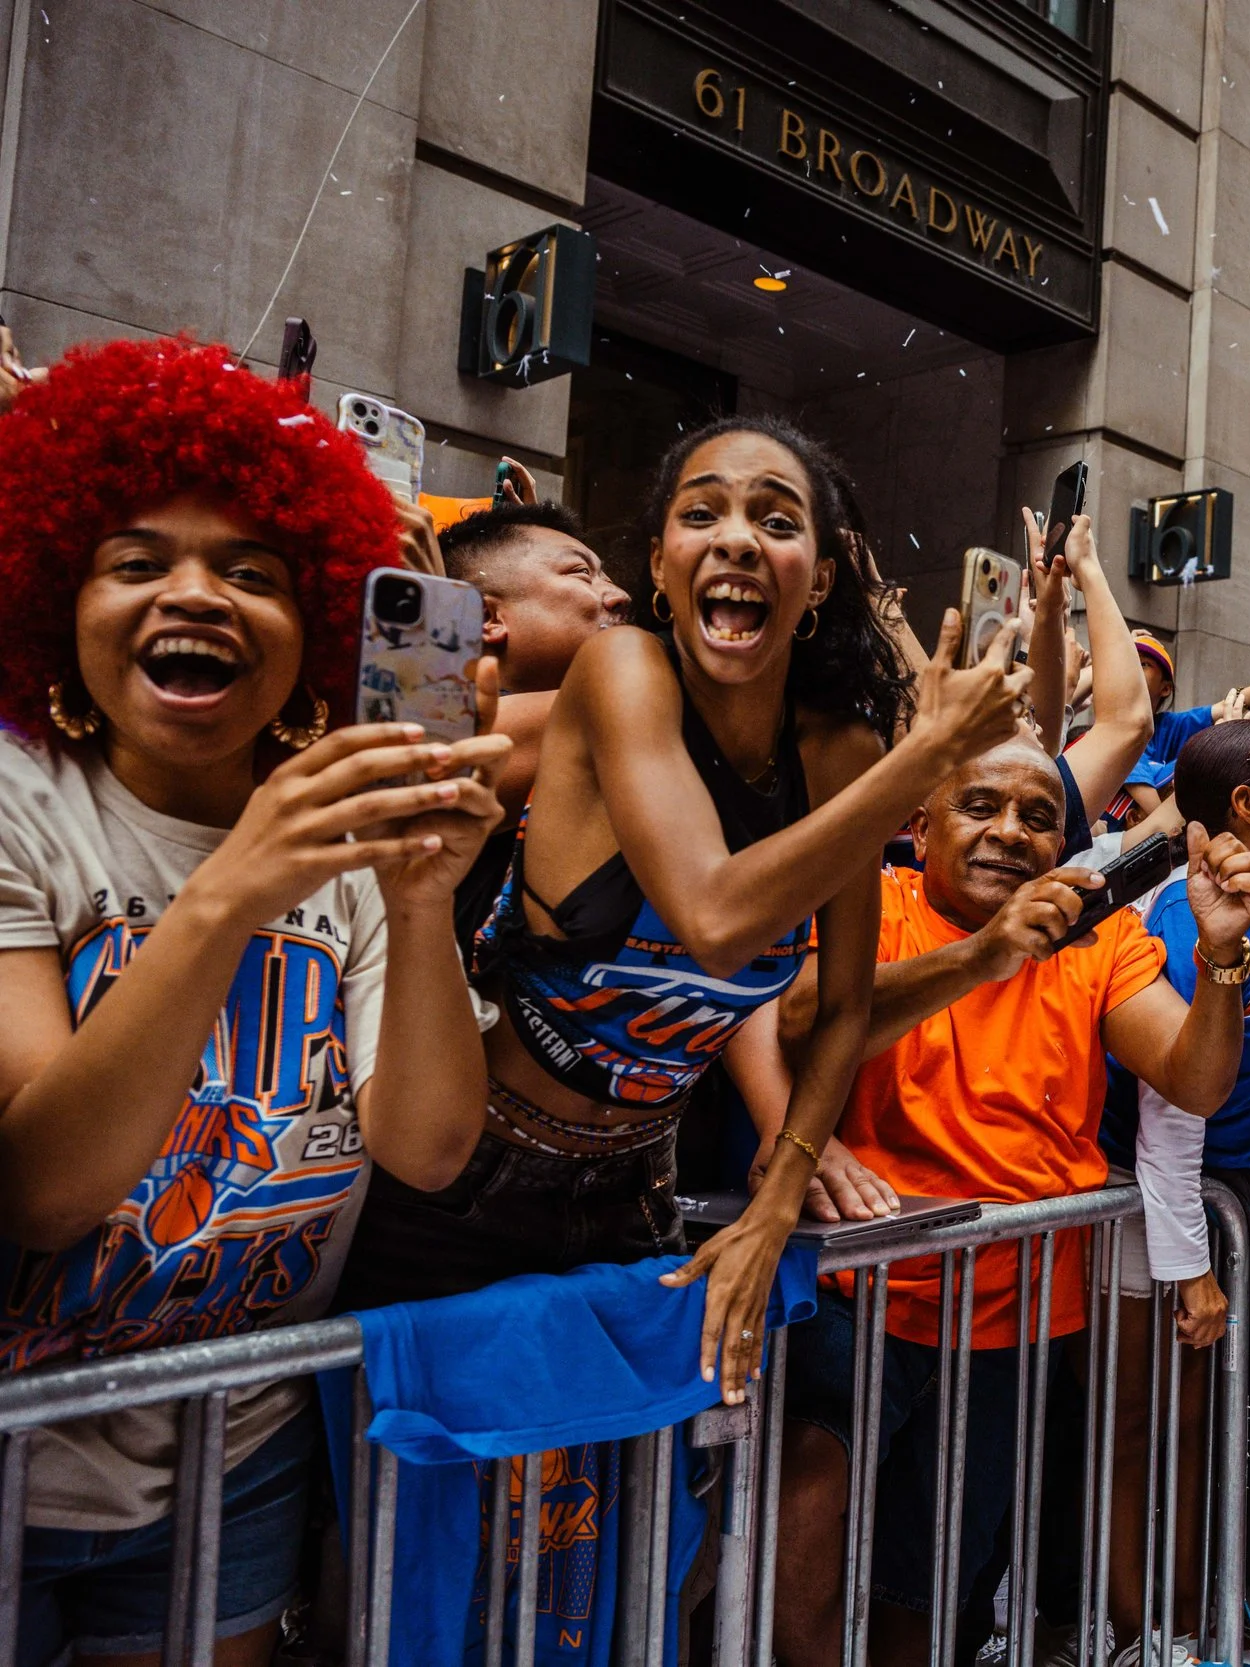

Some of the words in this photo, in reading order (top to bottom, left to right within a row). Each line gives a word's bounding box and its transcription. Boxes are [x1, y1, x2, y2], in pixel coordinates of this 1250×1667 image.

[693, 67, 747, 133] 61
[778, 108, 1044, 279] BROADWAY
[625, 936, 687, 956] EASTE
[301, 1122, 363, 1161] 26
